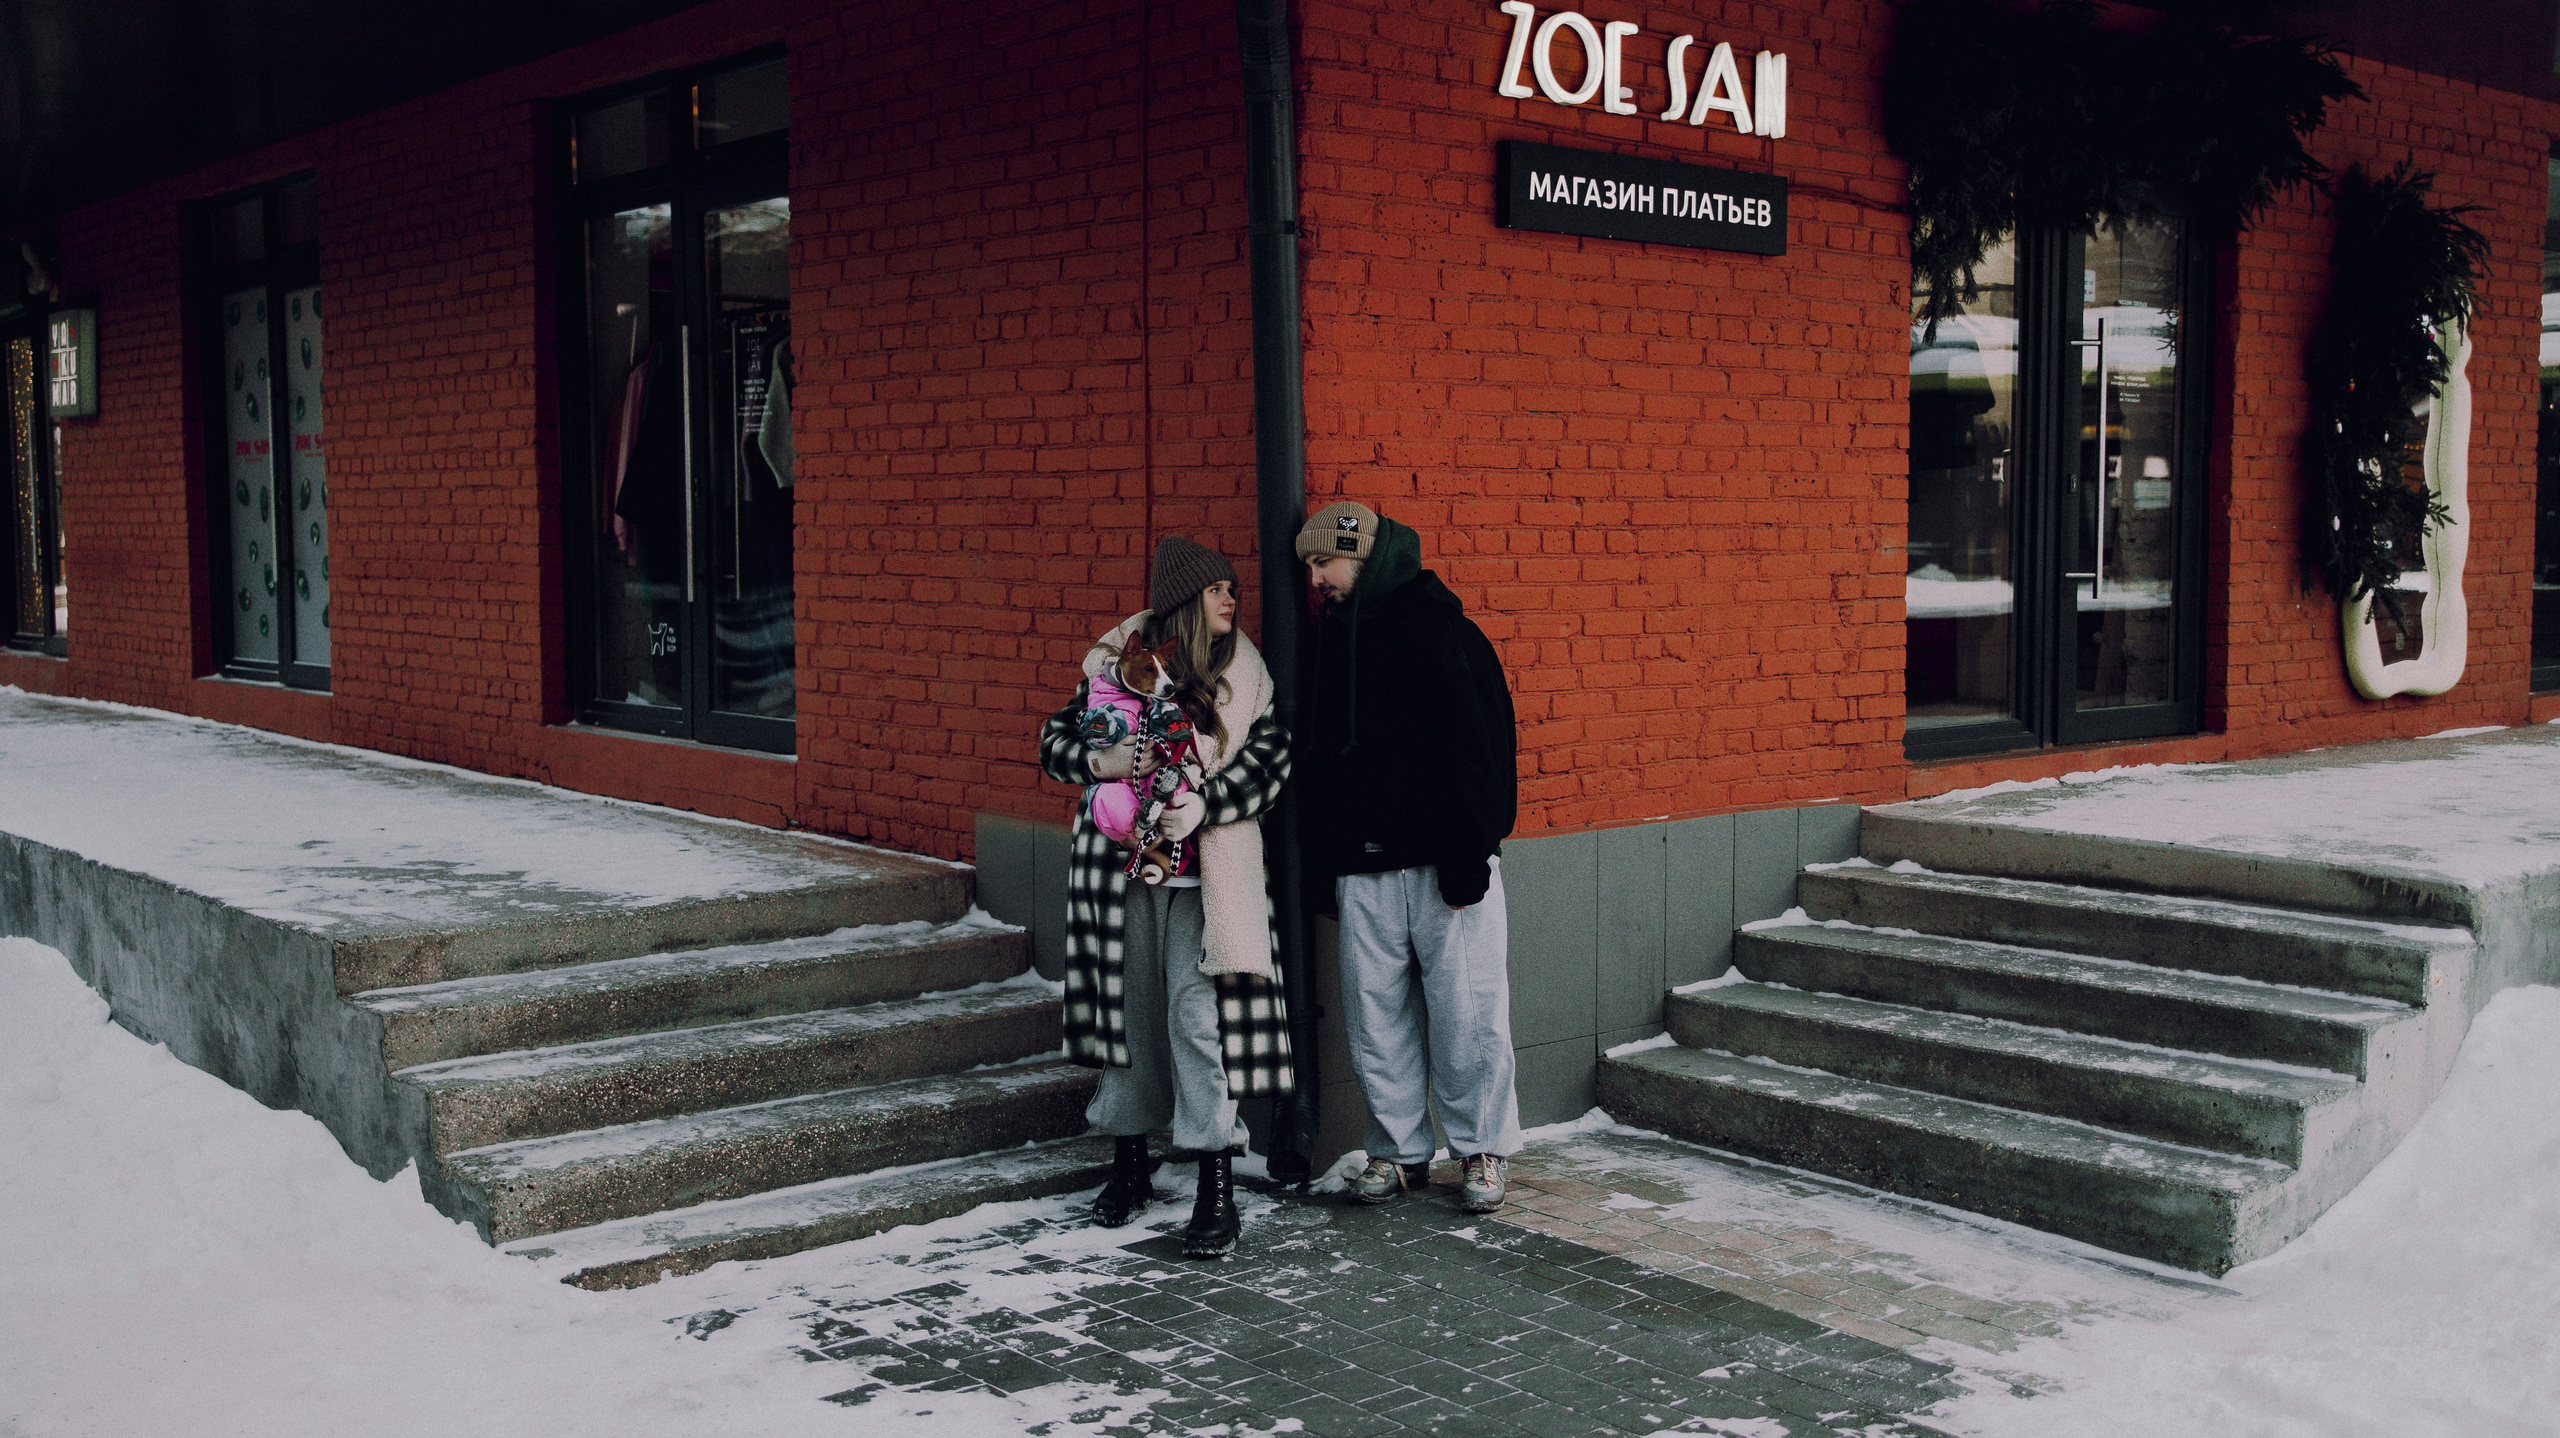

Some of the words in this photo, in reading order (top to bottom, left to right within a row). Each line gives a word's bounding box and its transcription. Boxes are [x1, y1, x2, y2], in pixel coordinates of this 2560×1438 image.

[1499, 1, 1639, 115] ZOE
[1660, 35, 1787, 139] SAN
[1529, 171, 1655, 214] МАГАЗИН
[1662, 187, 1772, 227] ПЛАТЬЕВ
